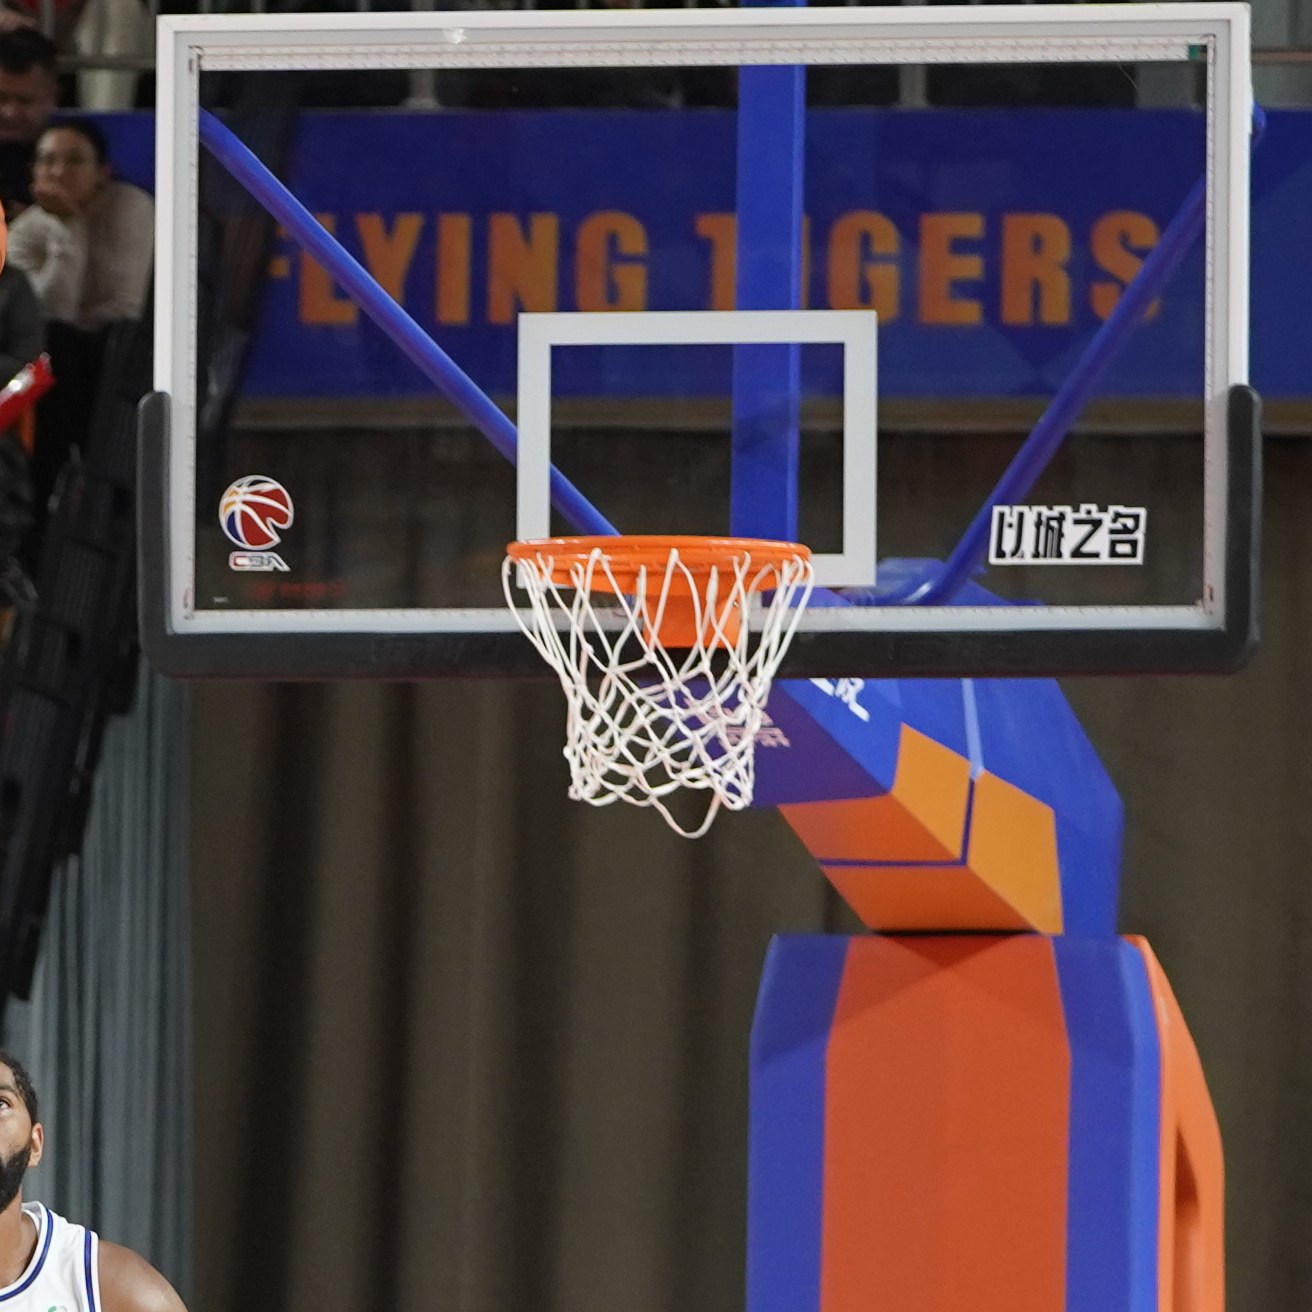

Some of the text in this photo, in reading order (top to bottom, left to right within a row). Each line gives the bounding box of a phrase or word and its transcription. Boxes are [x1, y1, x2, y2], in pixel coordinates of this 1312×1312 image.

[270, 210, 1161, 326] LYING TGERS
[992, 506, 1144, 561] 以城之名
